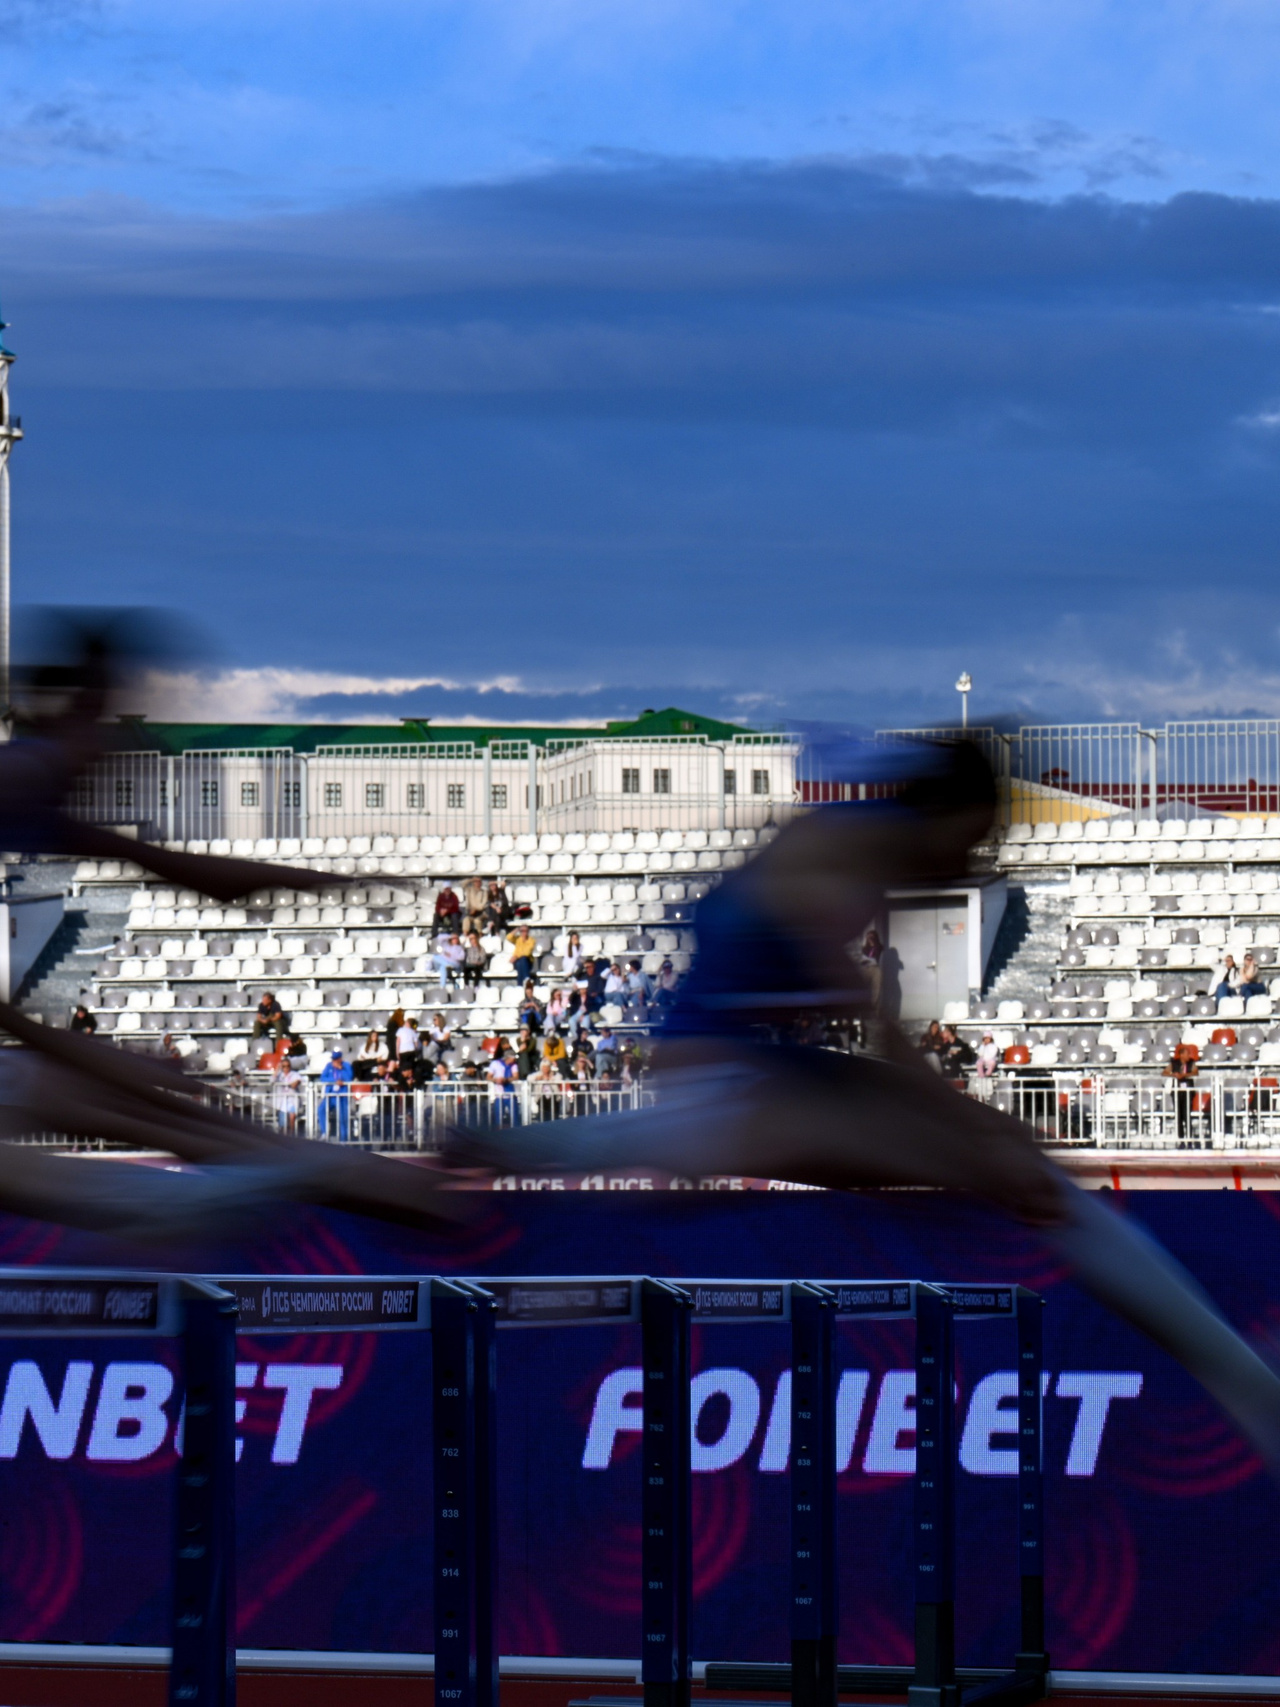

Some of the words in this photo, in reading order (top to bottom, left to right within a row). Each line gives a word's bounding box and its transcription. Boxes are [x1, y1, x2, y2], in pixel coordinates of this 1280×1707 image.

[43, 1291, 91, 1314] РОССИИ
[272, 1292, 290, 1313] ПСБ
[291, 1292, 340, 1312] ЧЕМПИОНАТ
[342, 1291, 373, 1312] РОССИИ
[381, 1290, 415, 1314] FONBET
[797, 1365, 812, 1373] 686
[648, 1371, 665, 1380] 686
[441, 1388, 459, 1397] 686
[797, 1411, 812, 1419] 762
[648, 1423, 665, 1432] 762
[441, 1448, 459, 1457] 762
[648, 1477, 665, 1486] 838
[441, 1509, 459, 1518] 838
[648, 1528, 664, 1536] 914
[441, 1568, 460, 1577] 914
[648, 1581, 664, 1590] 991
[795, 1597, 813, 1605] 1067
[442, 1629, 459, 1638] 991
[646, 1633, 666, 1642] 1067
[440, 1690, 462, 1699] 1067
